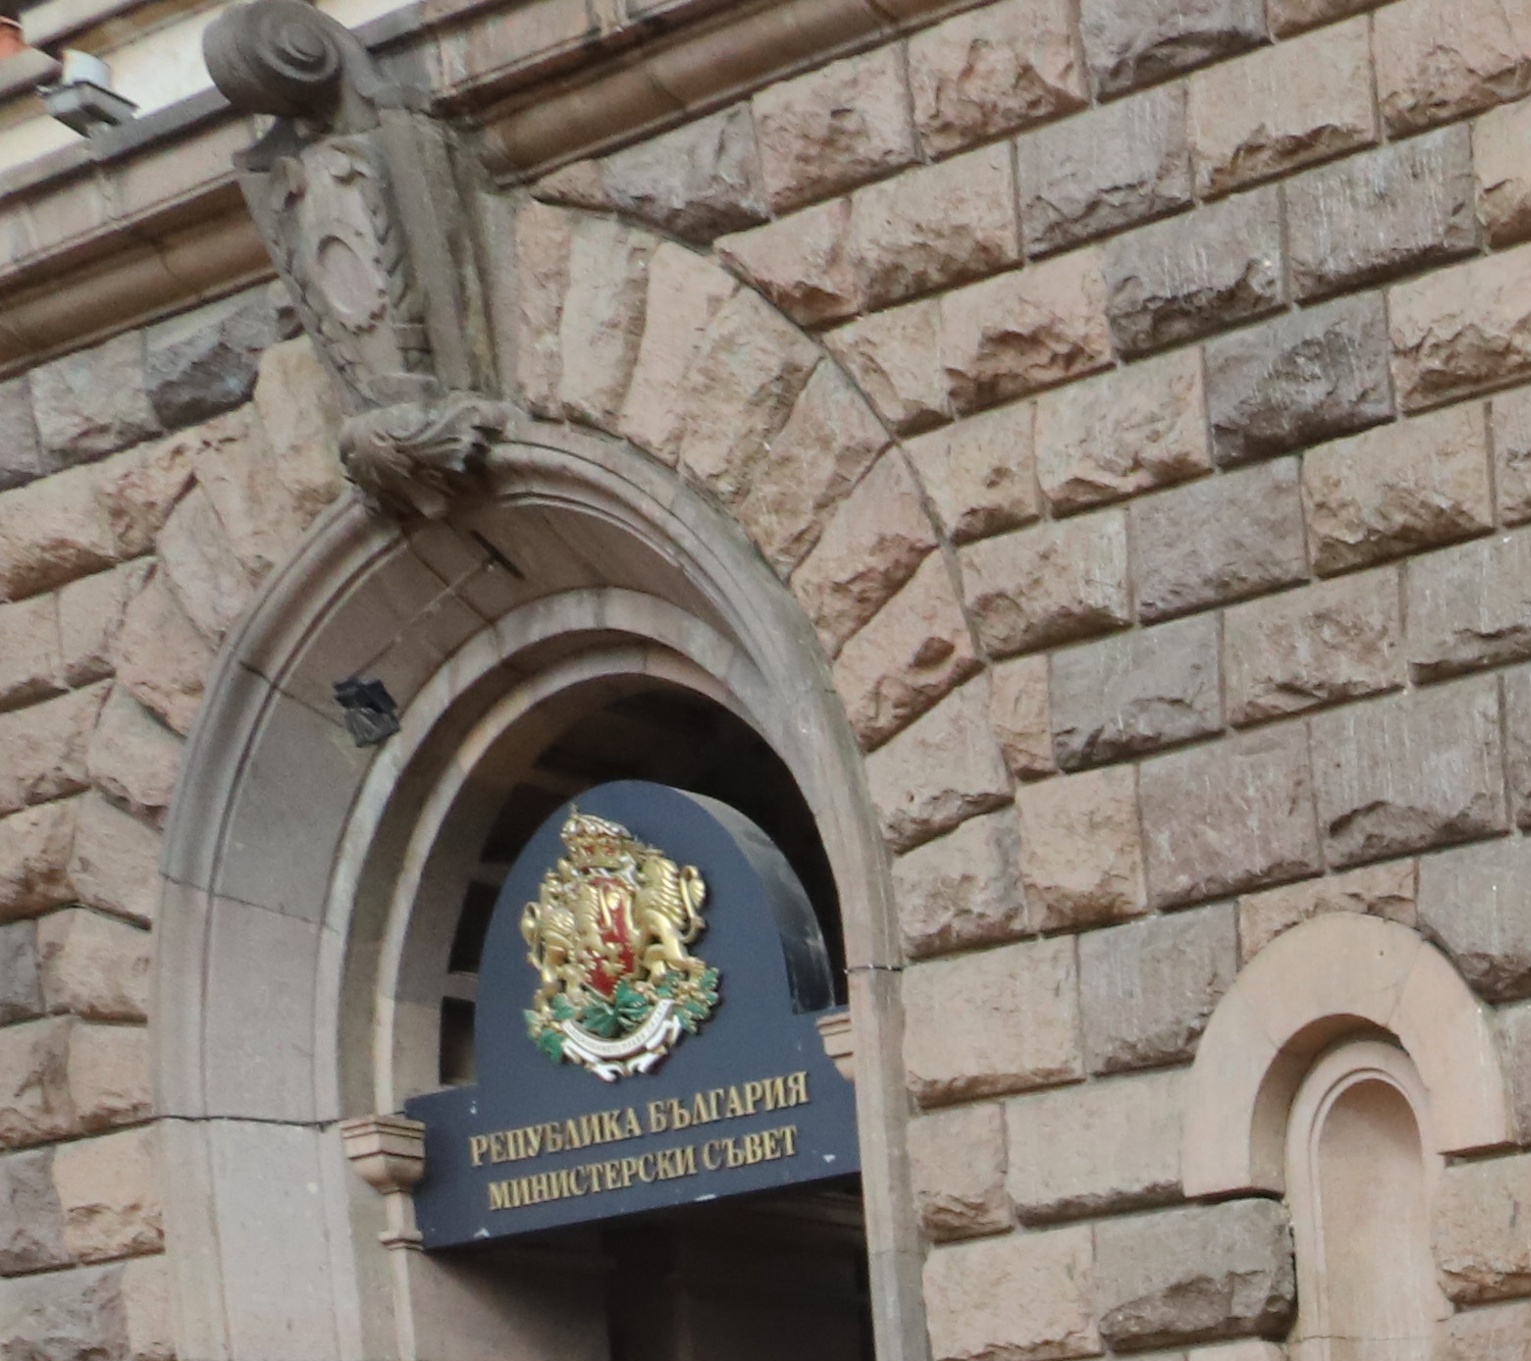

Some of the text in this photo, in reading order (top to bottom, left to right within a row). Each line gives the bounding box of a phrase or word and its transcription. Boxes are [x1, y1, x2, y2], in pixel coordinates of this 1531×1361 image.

[470, 1072, 811, 1167] РЕПУБЛИКА БЪЛГАРИЯ
[488, 1126, 798, 1211] МИНИСТЕРСКИ СЪВЕТ
